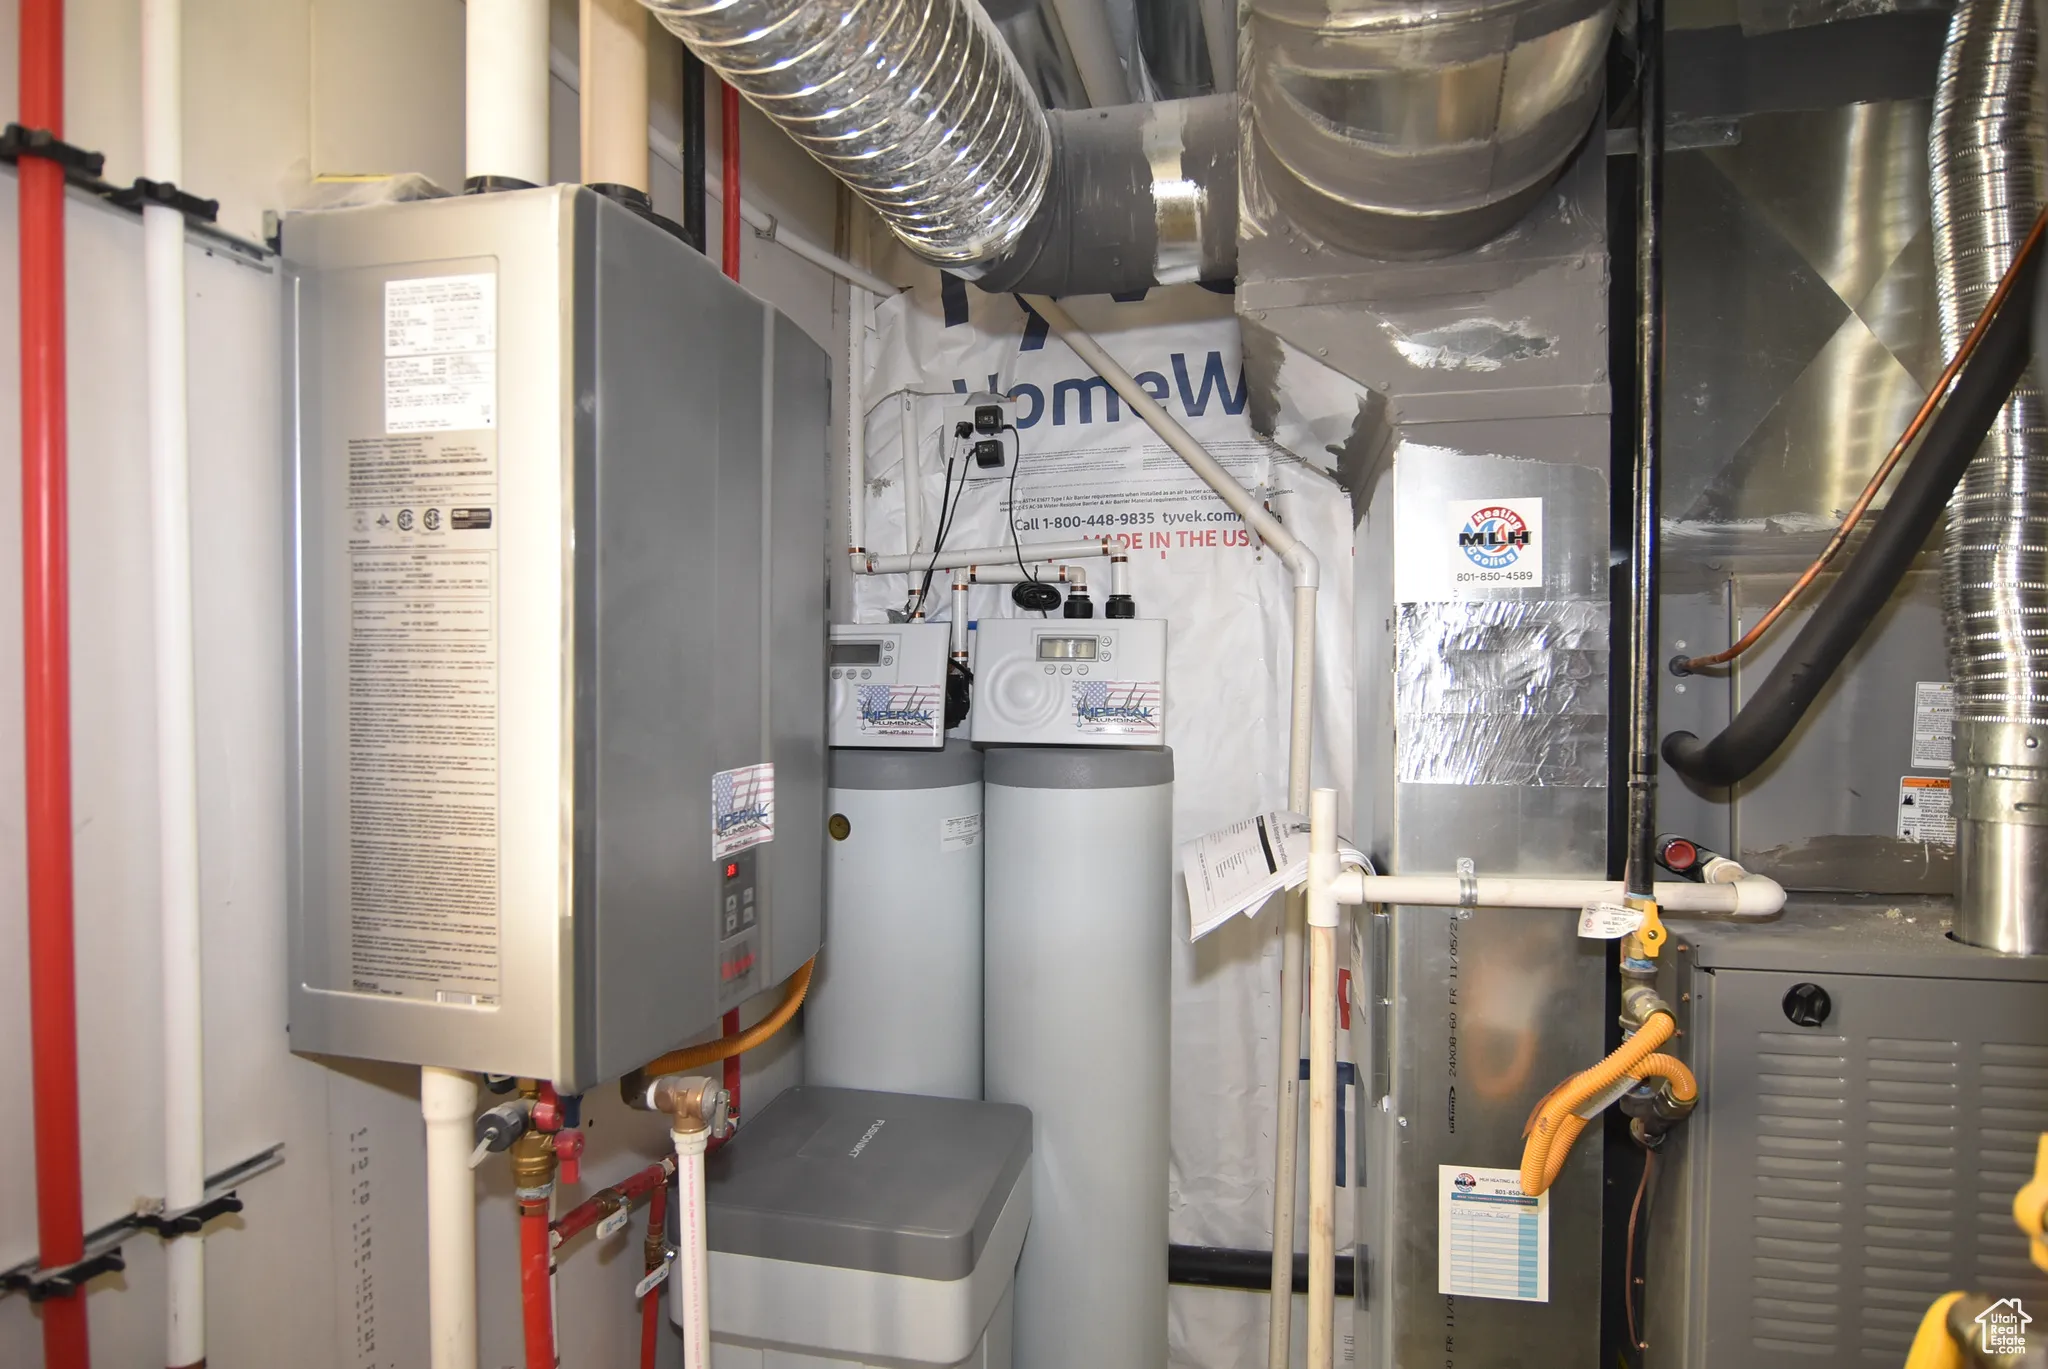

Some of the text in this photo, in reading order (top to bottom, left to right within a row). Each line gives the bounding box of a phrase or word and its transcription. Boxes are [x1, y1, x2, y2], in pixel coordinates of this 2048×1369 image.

[952, 351, 1247, 430] omeW
[1014, 510, 1242, 530] Call 1-800-448-9835 tyvek.com/
[1473, 508, 1522, 530] Heating
[1150, 531, 1170, 548] IN
[1176, 530, 1216, 548] THE
[1223, 530, 1258, 547] US
[1458, 531, 1532, 546] MLH
[1467, 546, 1516, 566] Cooling
[1456, 572, 1533, 582] 801-850-4589
[1448, 916, 1458, 980] 11/05/21
[1448, 988, 1458, 1006] FR
[1448, 1011, 1458, 1078] 24X08-60
[1446, 1336, 1454, 1353] FR
